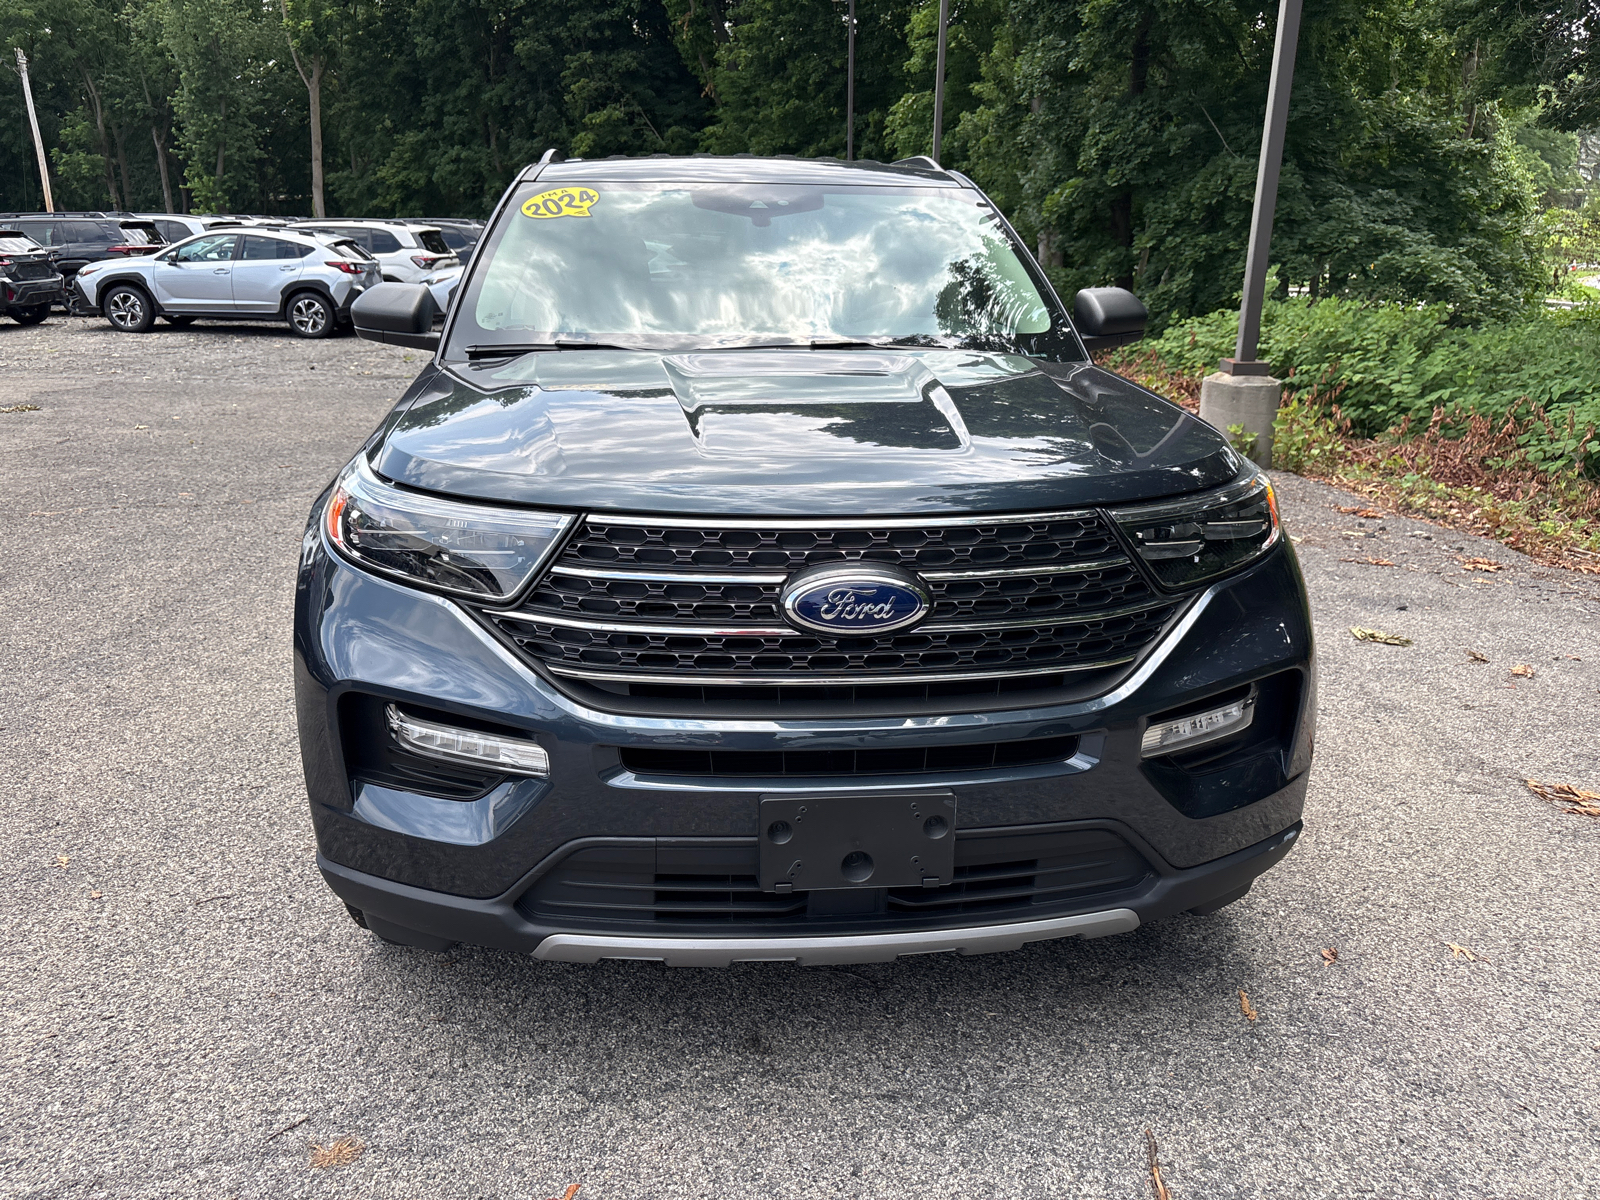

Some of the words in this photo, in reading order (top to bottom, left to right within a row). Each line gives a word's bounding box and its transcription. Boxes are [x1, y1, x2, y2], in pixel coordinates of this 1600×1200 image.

[525, 190, 596, 216] 2024
[541, 191, 558, 199] I'M
[820, 588, 897, 620] Ford
